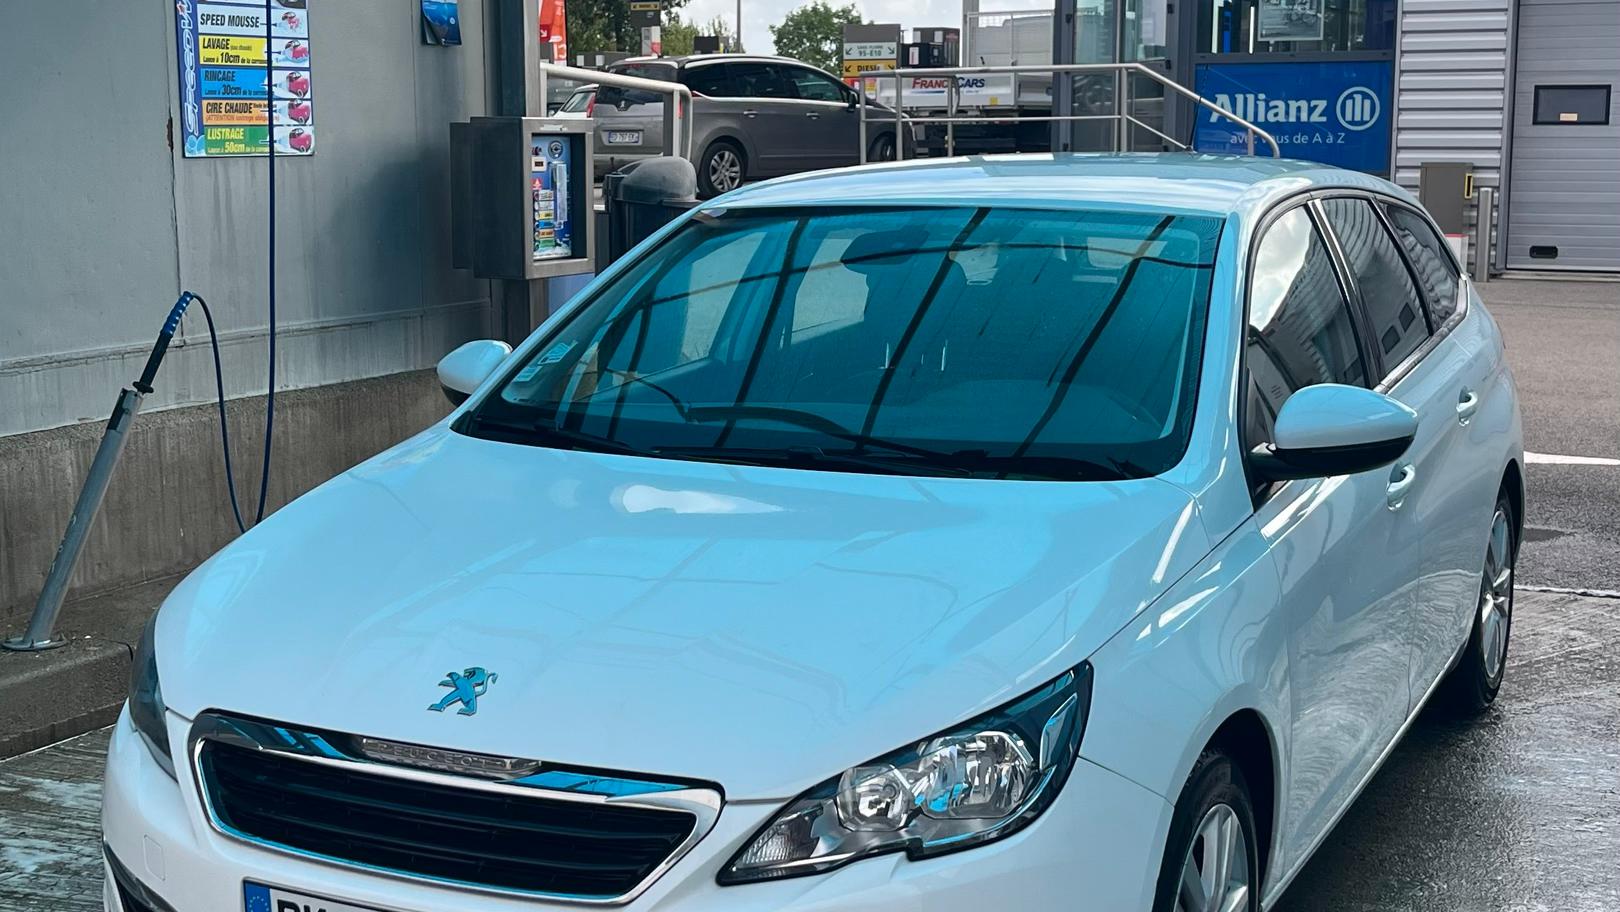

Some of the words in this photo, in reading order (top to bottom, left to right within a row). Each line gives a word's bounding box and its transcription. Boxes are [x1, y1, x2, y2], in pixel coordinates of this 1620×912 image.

[200, 13, 226, 26] SPEED
[228, 15, 260, 28] MOUSSE
[203, 37, 231, 50] LAVAGE
[220, 52, 240, 64] 10cm
[912, 77, 957, 89] FRANC
[206, 102, 223, 114] CIRE
[224, 103, 253, 114] CHAUDE
[1209, 93, 1327, 123] Allianz
[207, 128, 245, 140] LUSTRAGE
[1293, 132, 1309, 144] de
[1312, 133, 1323, 144] A
[1326, 131, 1334, 144] à
[1336, 133, 1345, 144] Z
